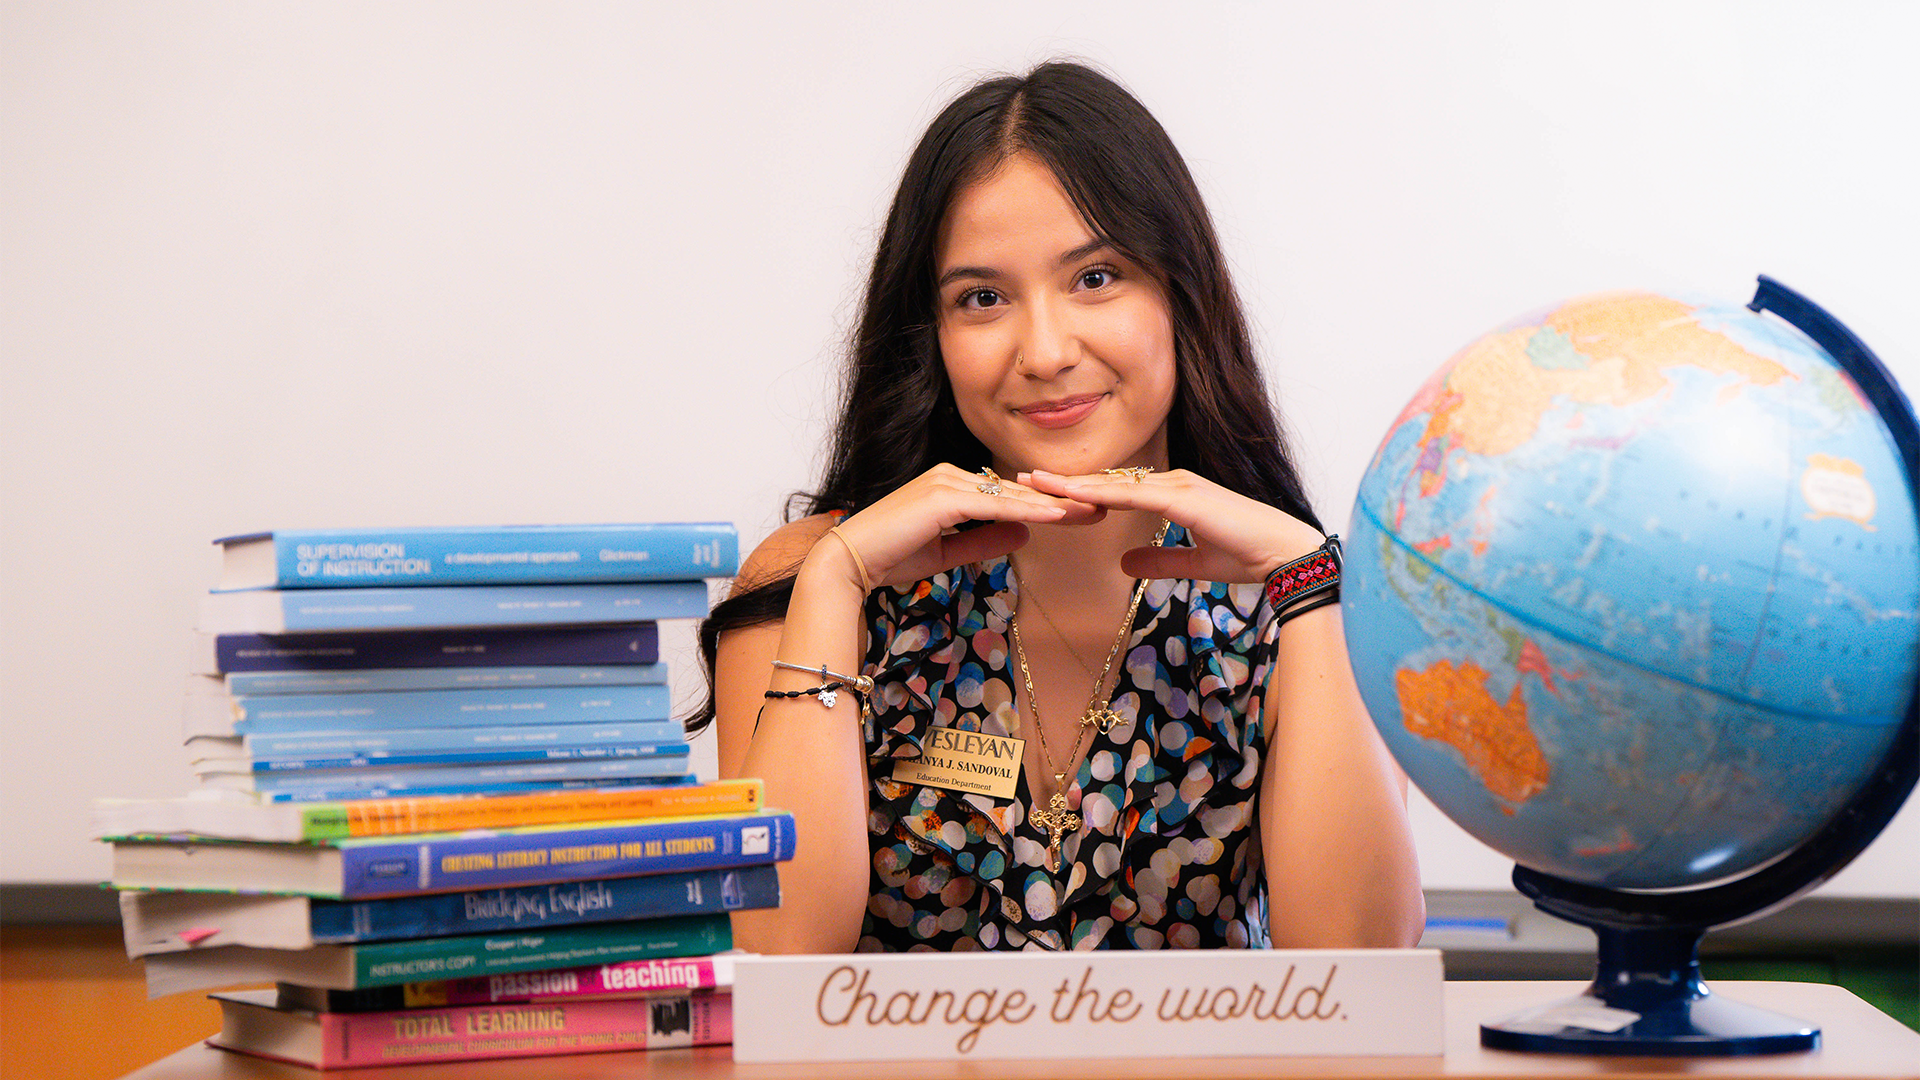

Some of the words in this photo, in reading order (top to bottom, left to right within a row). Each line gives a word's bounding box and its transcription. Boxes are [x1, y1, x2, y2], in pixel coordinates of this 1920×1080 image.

[297, 543, 405, 559] SUPERVISION
[600, 549, 648, 562] Glickman
[297, 561, 317, 577] OF
[323, 558, 431, 576] INSTRUCTION
[946, 760, 955, 770] J.
[957, 761, 1013, 779] SANDOVAL
[916, 773, 950, 785] Education
[951, 777, 992, 791] Department
[441, 854, 494, 873] CREATING
[497, 850, 548, 869] LITERACY
[550, 845, 617, 865] INSTRUCTION
[620, 842, 641, 859] FOR
[645, 840, 663, 857] ALL
[666, 836, 715, 856] STUDENTS
[446, 955, 477, 971] COPY
[489, 971, 579, 1002] passion
[601, 961, 700, 988] teaching
[816, 965, 1037, 1054] Change
[1050, 966, 1143, 1024] the
[1157, 963, 1349, 1023] world.
[393, 1015, 454, 1039] TOTAL
[467, 1008, 564, 1035] LEARNING
[467, 1038, 534, 1053] CURRICULUM
[536, 1035, 557, 1048] FOR
[559, 1034, 578, 1046] THE
[580, 1031, 614, 1045] YOUNG
[616, 1030, 646, 1043] CHILD
